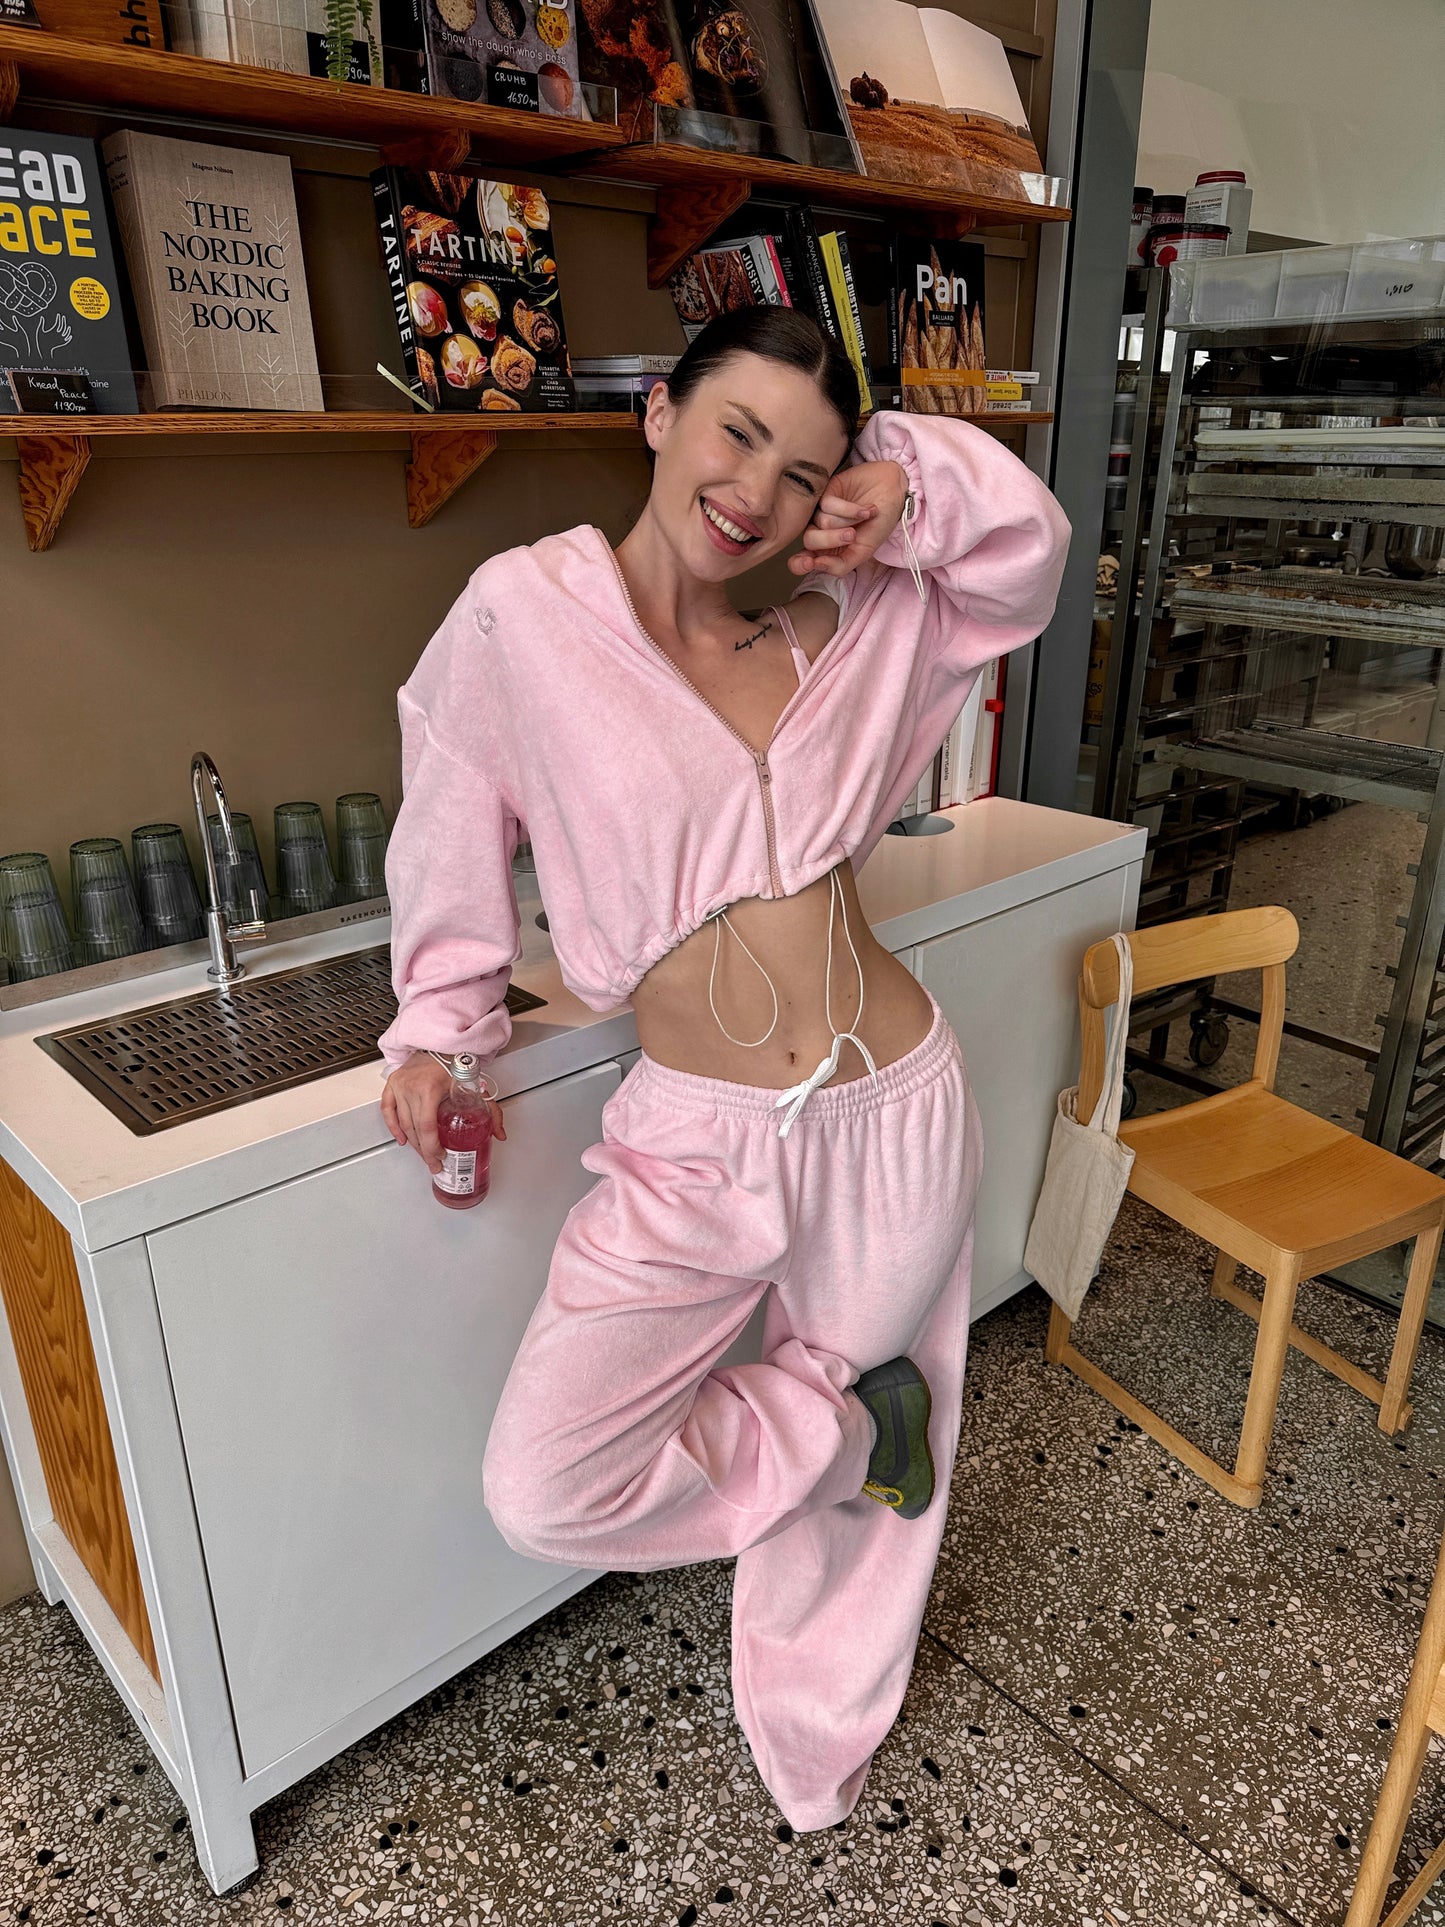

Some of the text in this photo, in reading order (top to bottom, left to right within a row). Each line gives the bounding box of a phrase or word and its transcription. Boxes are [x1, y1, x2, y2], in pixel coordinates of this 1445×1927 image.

[240, 54, 295, 73] PHAIDON
[442, 31, 567, 65] show the dough who's boss
[495, 72, 527, 86] CRUMB
[186, 200, 252, 233] THE
[160, 231, 286, 270] NORDIC
[410, 228, 524, 267] TARTINE
[165, 266, 290, 303] BAKING
[380, 214, 413, 344] TARTINE
[742, 252, 763, 294] JOSEY
[806, 235, 823, 286] ADVANCED
[818, 284, 832, 322] BREAD
[843, 263, 853, 284] THE
[916, 264, 968, 305] Pan
[847, 283, 859, 315] DUSTY
[190, 303, 280, 334] BOOK
[932, 314, 955, 322] BALUARD
[648, 360, 662, 368] THE
[27, 376, 60, 390] Knead
[60, 388, 89, 399] Peace
[176, 388, 232, 401] PHAIDON
